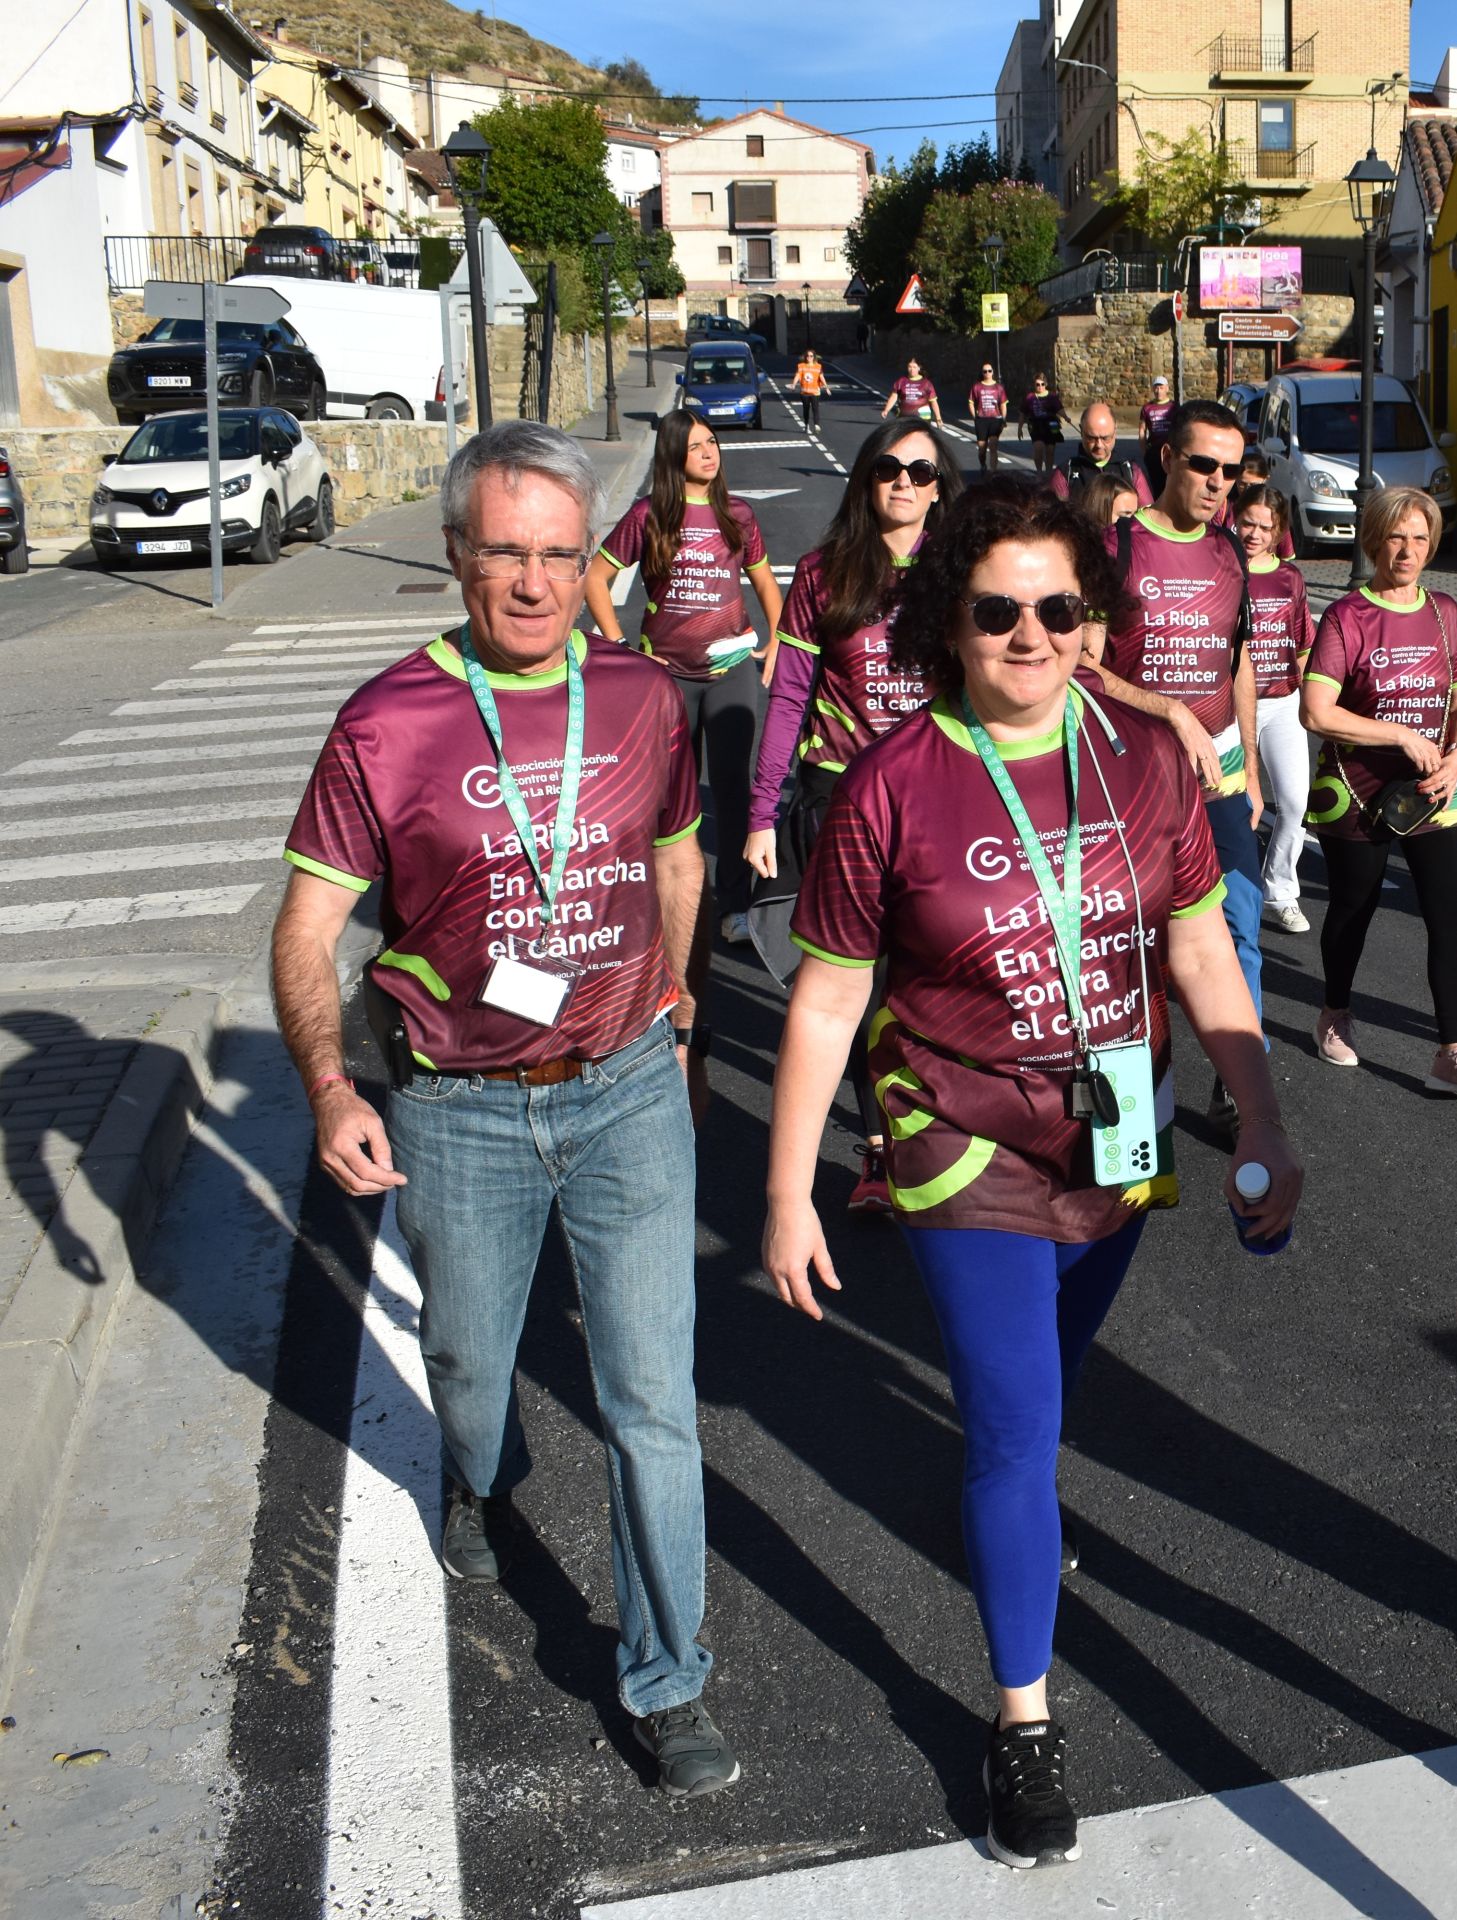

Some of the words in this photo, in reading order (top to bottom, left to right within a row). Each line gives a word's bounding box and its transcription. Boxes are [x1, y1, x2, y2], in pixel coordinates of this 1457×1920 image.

[144, 543, 166, 552] 3294
[672, 551, 682, 562] a
[685, 549, 715, 563] Rioja
[684, 566, 731, 579] marcha
[678, 590, 721, 602] cáncer
[1144, 611, 1165, 626] La
[1169, 610, 1209, 629] Rioja
[1260, 620, 1287, 634] Rioja
[864, 637, 888, 653] La
[1144, 634, 1165, 649] En
[1169, 634, 1227, 649] marcha
[1142, 651, 1198, 666] contra
[865, 660, 888, 676] En
[1142, 667, 1159, 682] el
[1163, 668, 1218, 682] cáncer
[865, 679, 924, 694] contra
[1376, 679, 1396, 692] La
[1400, 674, 1436, 690] Rioja
[866, 696, 884, 711] el
[1377, 698, 1395, 709] En
[508, 757, 565, 774] asociación
[549, 771, 559, 782] el
[530, 788, 544, 798] La
[481, 833, 524, 860] La
[489, 873, 526, 900] En
[485, 900, 594, 930] contra
[984, 905, 1030, 935] La
[994, 948, 1041, 979] En
[1011, 1011, 1045, 1041] el
